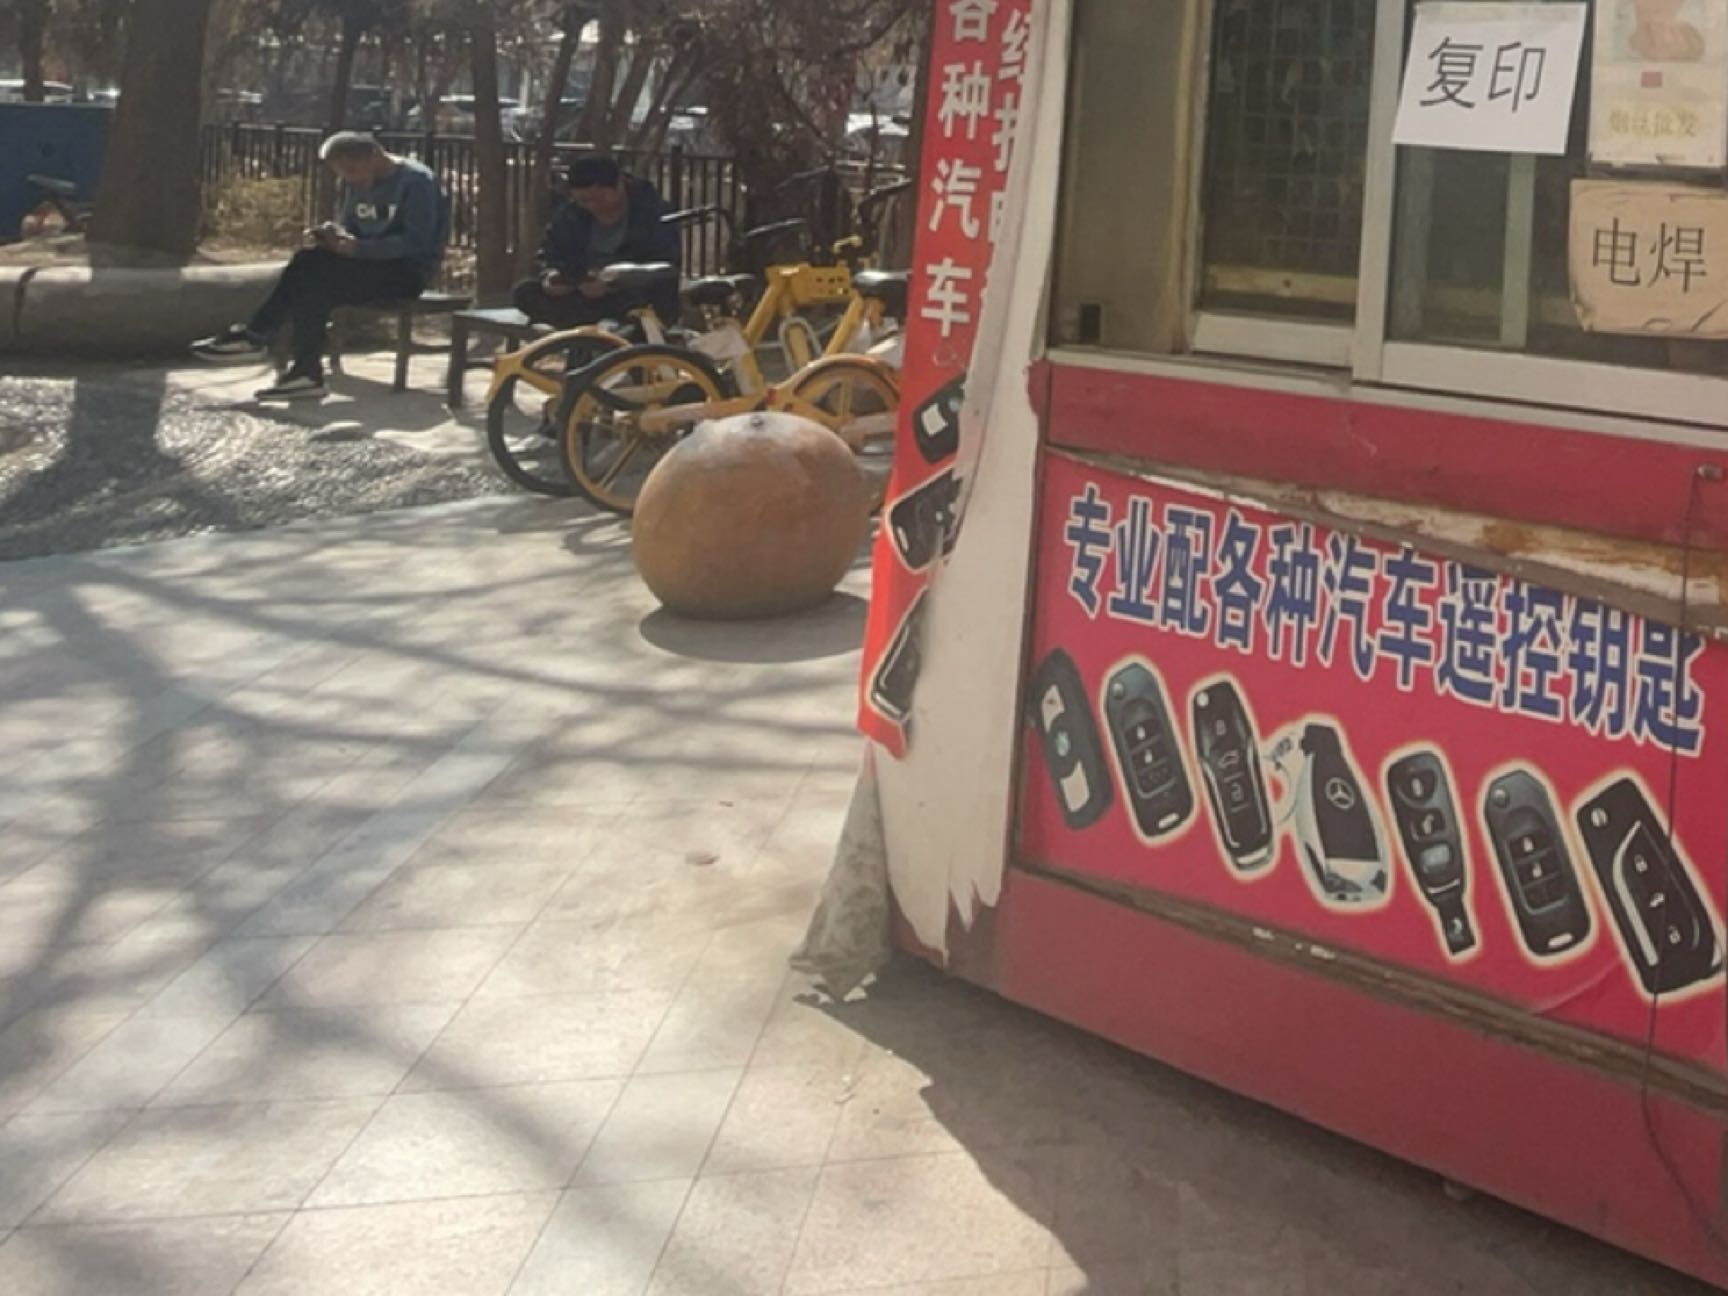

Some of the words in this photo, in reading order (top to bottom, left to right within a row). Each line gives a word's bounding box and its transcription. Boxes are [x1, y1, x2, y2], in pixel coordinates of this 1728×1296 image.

[1419, 36, 1546, 113] 复印
[1592, 217, 1708, 293] 电焊
[1064, 485, 1705, 758] 专业配各种汽车遥控钥匙
